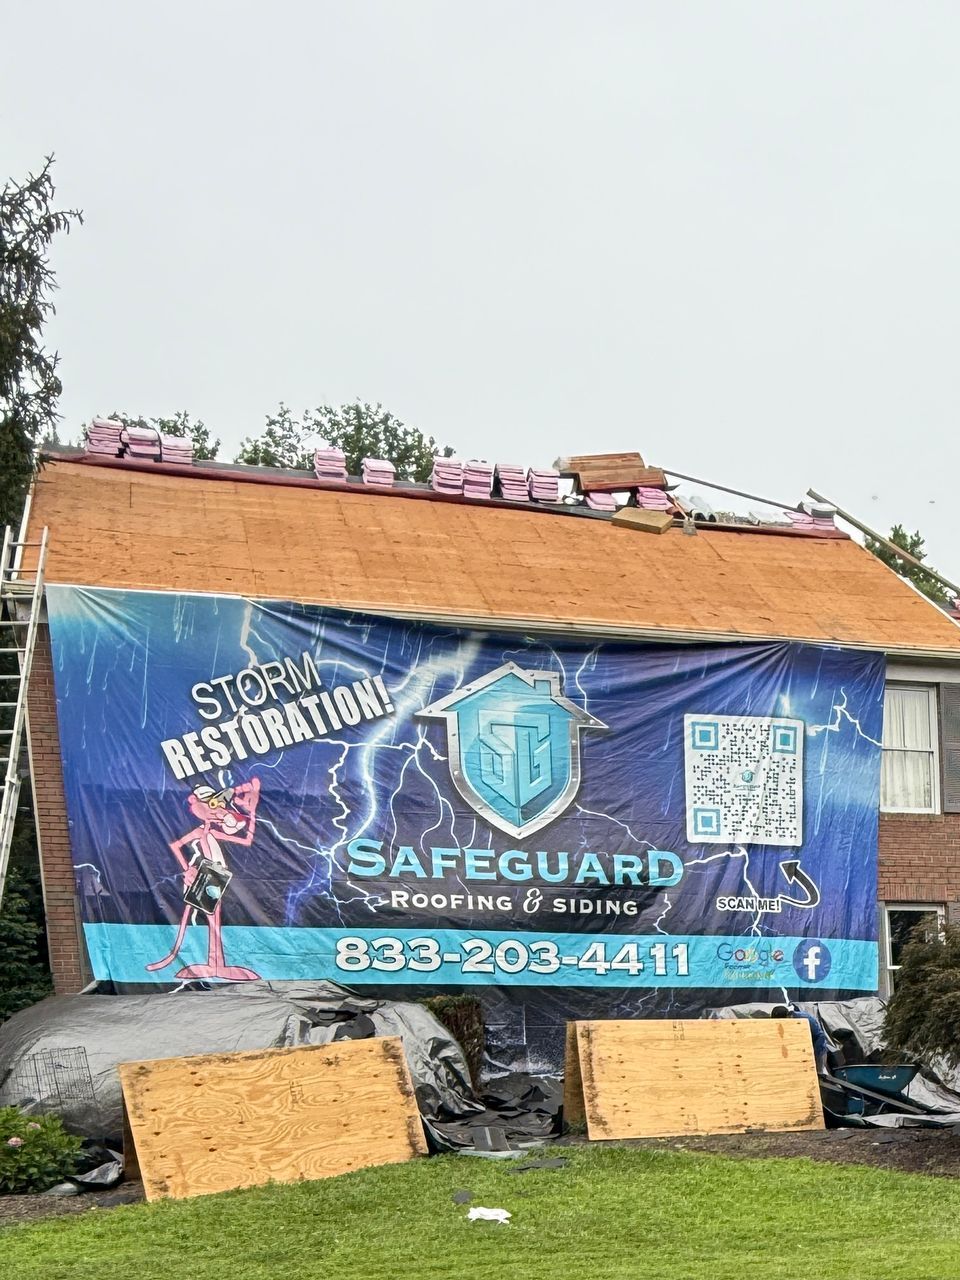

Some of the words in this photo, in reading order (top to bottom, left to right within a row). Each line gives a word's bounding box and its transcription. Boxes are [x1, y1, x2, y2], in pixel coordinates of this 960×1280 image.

[191, 652, 321, 720] STORM
[161, 675, 394, 779] RESTORATION!
[347, 840, 684, 887] SAFEGUARD
[391, 889, 513, 911] ROOFING
[523, 887, 543, 914] &
[553, 899, 638, 915] SIDING
[717, 897, 756, 911] SCAN
[757, 899, 781, 912] ME!
[335, 936, 690, 976] 833-203-4411
